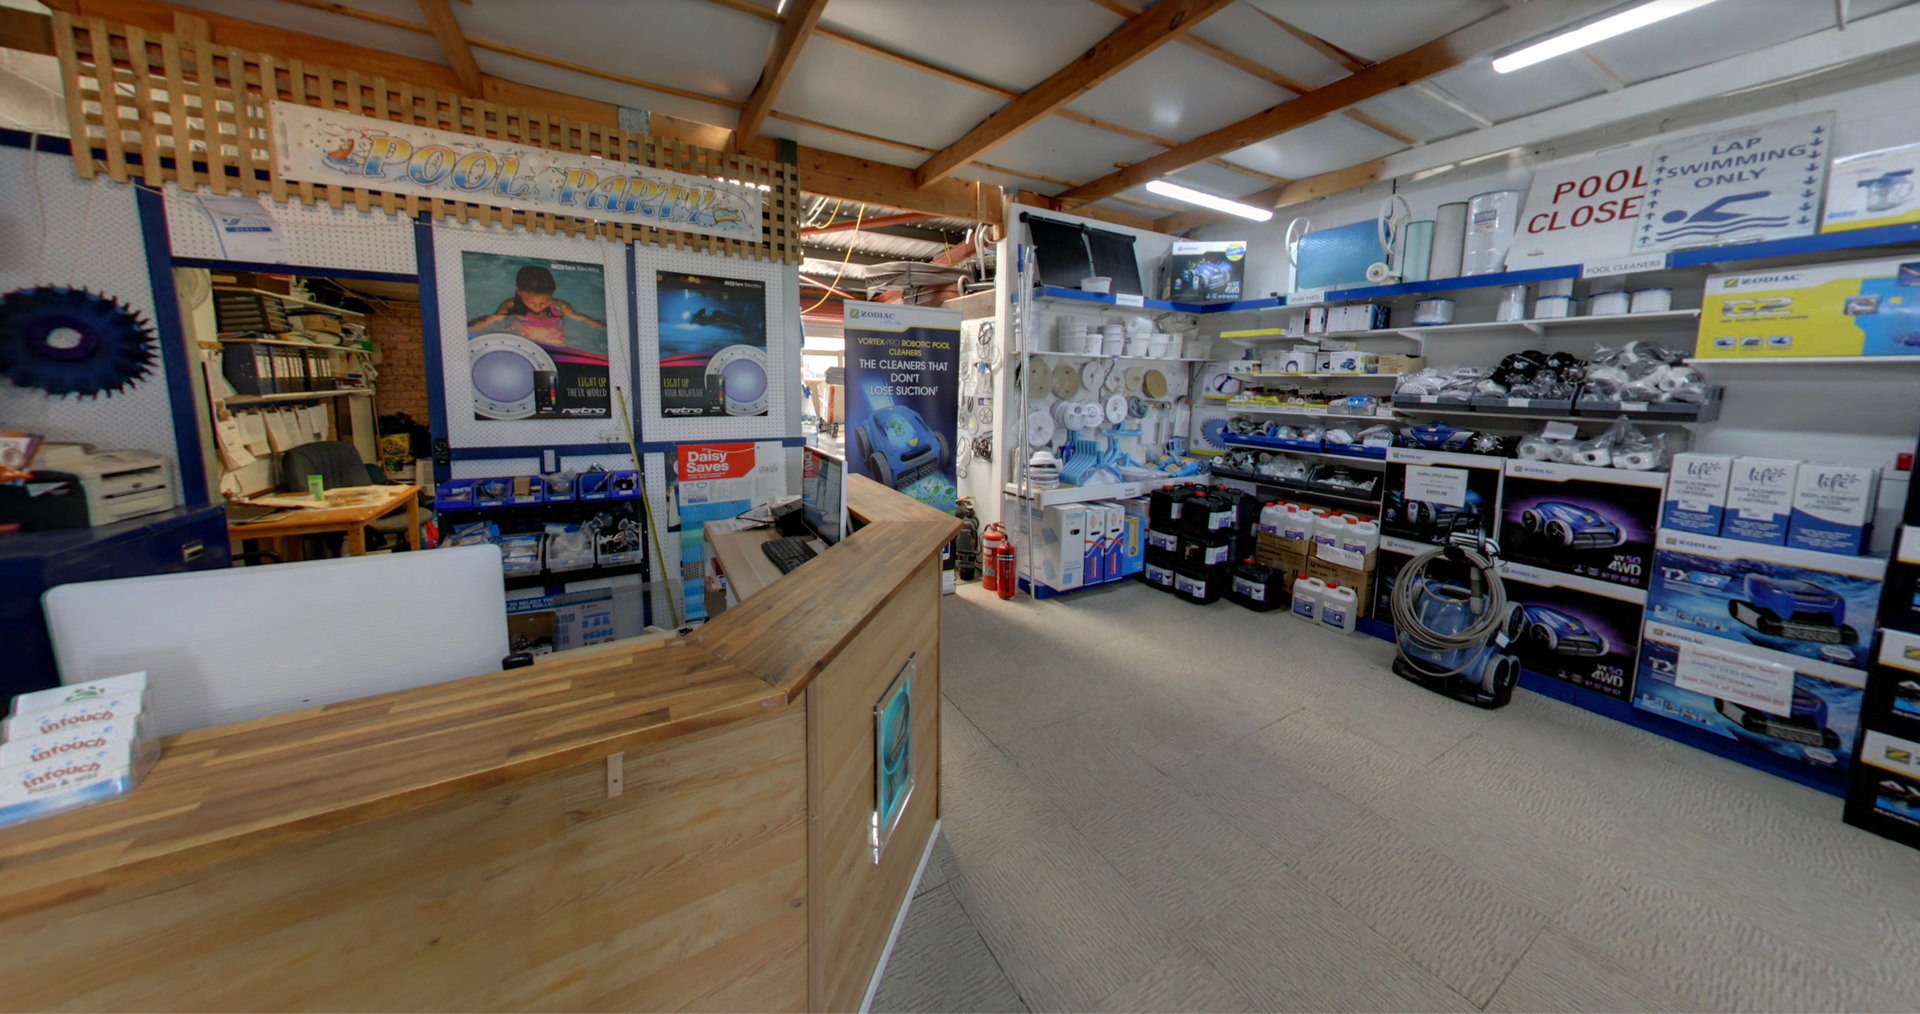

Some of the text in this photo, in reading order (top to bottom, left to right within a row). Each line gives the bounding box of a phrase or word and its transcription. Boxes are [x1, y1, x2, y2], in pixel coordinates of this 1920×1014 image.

[1711, 136, 1762, 156] LAP
[1666, 144, 1807, 179] SWIMMING
[362, 135, 715, 225] POOL PARTY
[1693, 166, 1767, 189] ONLY
[1552, 165, 1648, 204] POOL
[1586, 259, 1662, 274] POOL CLEANERS
[1740, 274, 1801, 285] ZODIAC
[1721, 297, 1794, 318] G2
[860, 311, 895, 319] ZODIAC
[857, 337, 885, 346] VORTEX
[901, 340, 931, 348] ROBOTIC
[931, 341, 950, 349] POOL
[888, 348, 922, 356] CLEANERS
[859, 358, 948, 371] THE CLEANERS THAT
[577, 377, 607, 387] LIGHT UP
[663, 377, 690, 388] LIGHT UP
[890, 373, 920, 383] DON'T
[566, 388, 607, 397] THEIR WORLD
[870, 386, 893, 396] LOSE
[687, 451, 727, 463] Daisy
[686, 461, 729, 474] Saves
[758, 464, 778, 473] daisy
[1523, 467, 1553, 475] ZODIAC
[1688, 462, 1713, 479] life
[1748, 467, 1777, 485] life
[1817, 472, 1849, 492] life
[1679, 540, 1720, 550] ZODIAC
[1511, 569, 1541, 579] ZODIAC
[1608, 560, 1641, 576] 4WD
[1591, 669, 1624, 687] 4WD
